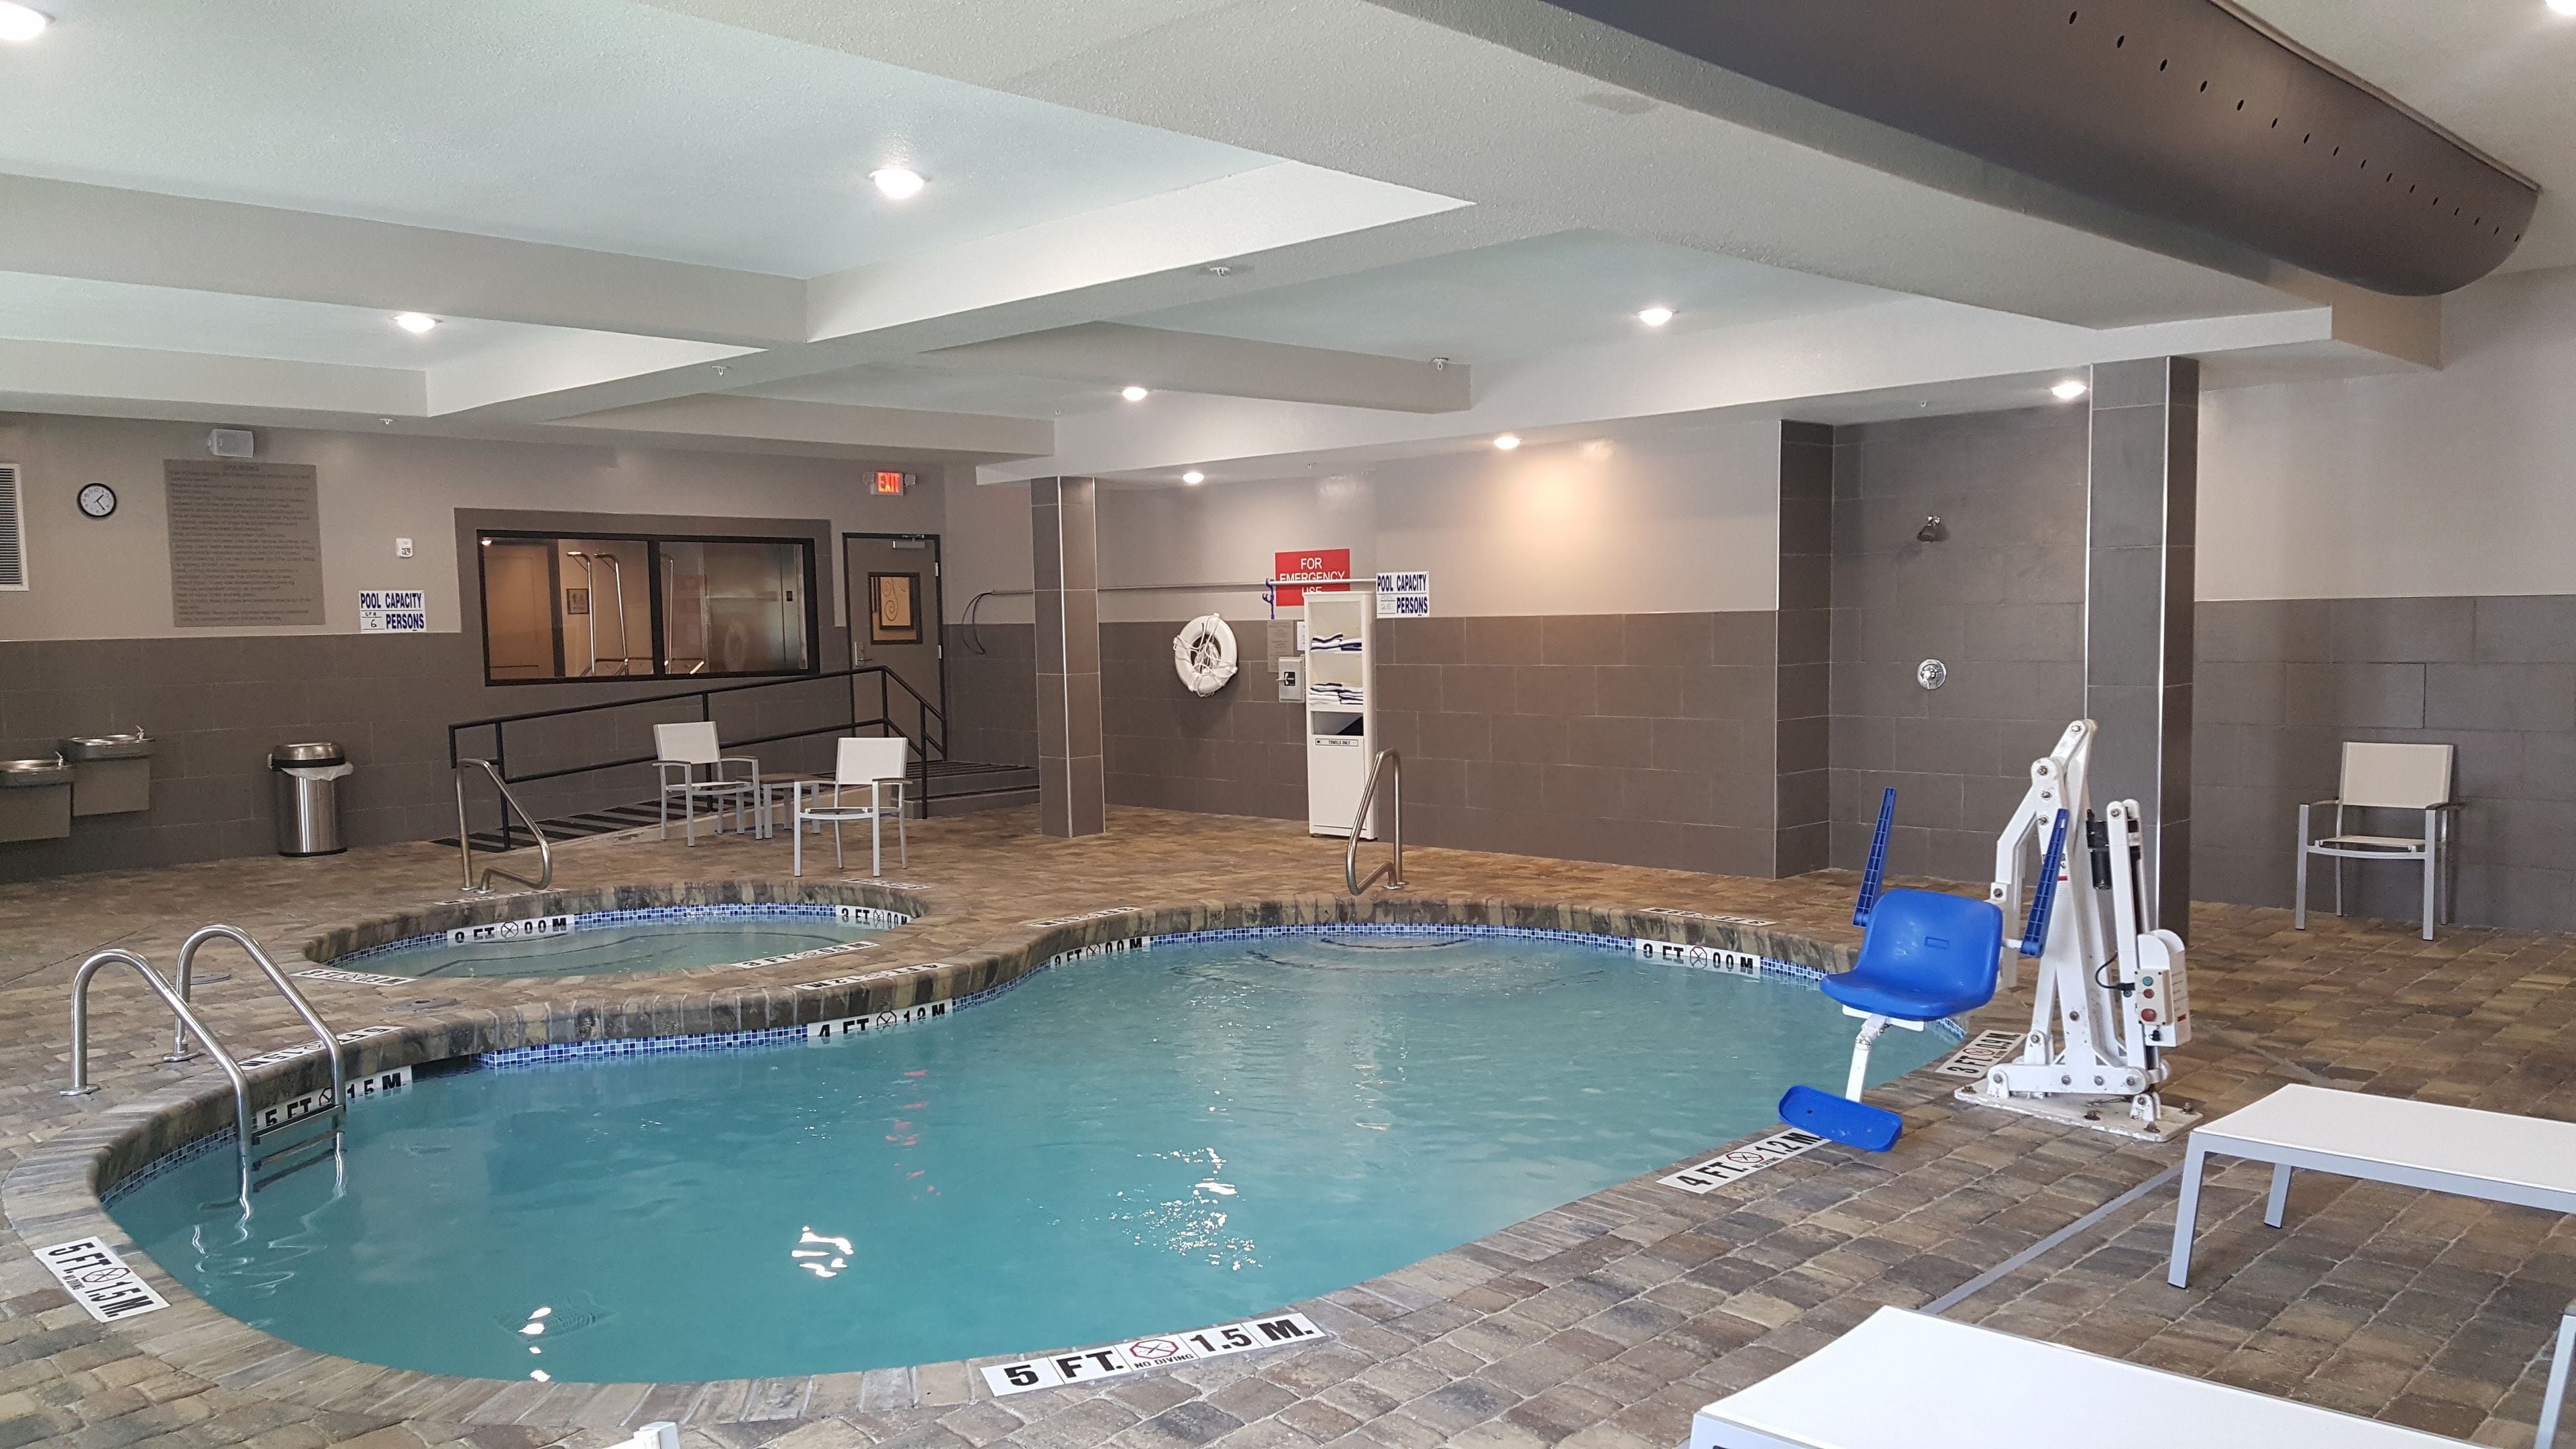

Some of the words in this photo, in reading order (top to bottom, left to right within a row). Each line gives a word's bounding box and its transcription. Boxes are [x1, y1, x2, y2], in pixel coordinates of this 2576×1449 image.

[878, 472, 900, 493] EXIT
[1301, 557, 1322, 570] FOR
[1279, 571, 1345, 582] EMERGENCY
[1377, 575, 1393, 592] POOL
[1397, 574, 1427, 591] CAPACITY
[360, 593, 381, 608] POOL
[385, 592, 422, 608] CAPACITY
[1397, 596, 1428, 614] PERSONS
[370, 619, 377, 628] 6
[386, 613, 424, 629] PERSONS
[818, 1024, 830, 1037] 4
[843, 1018, 869, 1034] FT
[1946, 1066, 1980, 1074] 3
[265, 1109, 278, 1126] 5
[286, 1097, 312, 1119] FT
[1676, 1175, 1713, 1186] 4
[1695, 1161, 1749, 1179] FT.
[1754, 1140, 1804, 1155] 1.2
[48, 1242, 96, 1256] 5
[56, 1252, 113, 1274] FT.
[66, 1279, 85, 1290] DIVING
[85, 1281, 142, 1301] 1.5
[99, 1295, 155, 1318] M.
[1004, 1364, 1039, 1386] 5
[1056, 1350, 1124, 1379] FT.
[1190, 1328, 1252, 1352] 1.5
[1257, 1319, 1316, 1341] M.
[1134, 1361, 1151, 1369] NO
[1157, 1353, 1195, 1365] DIVING
